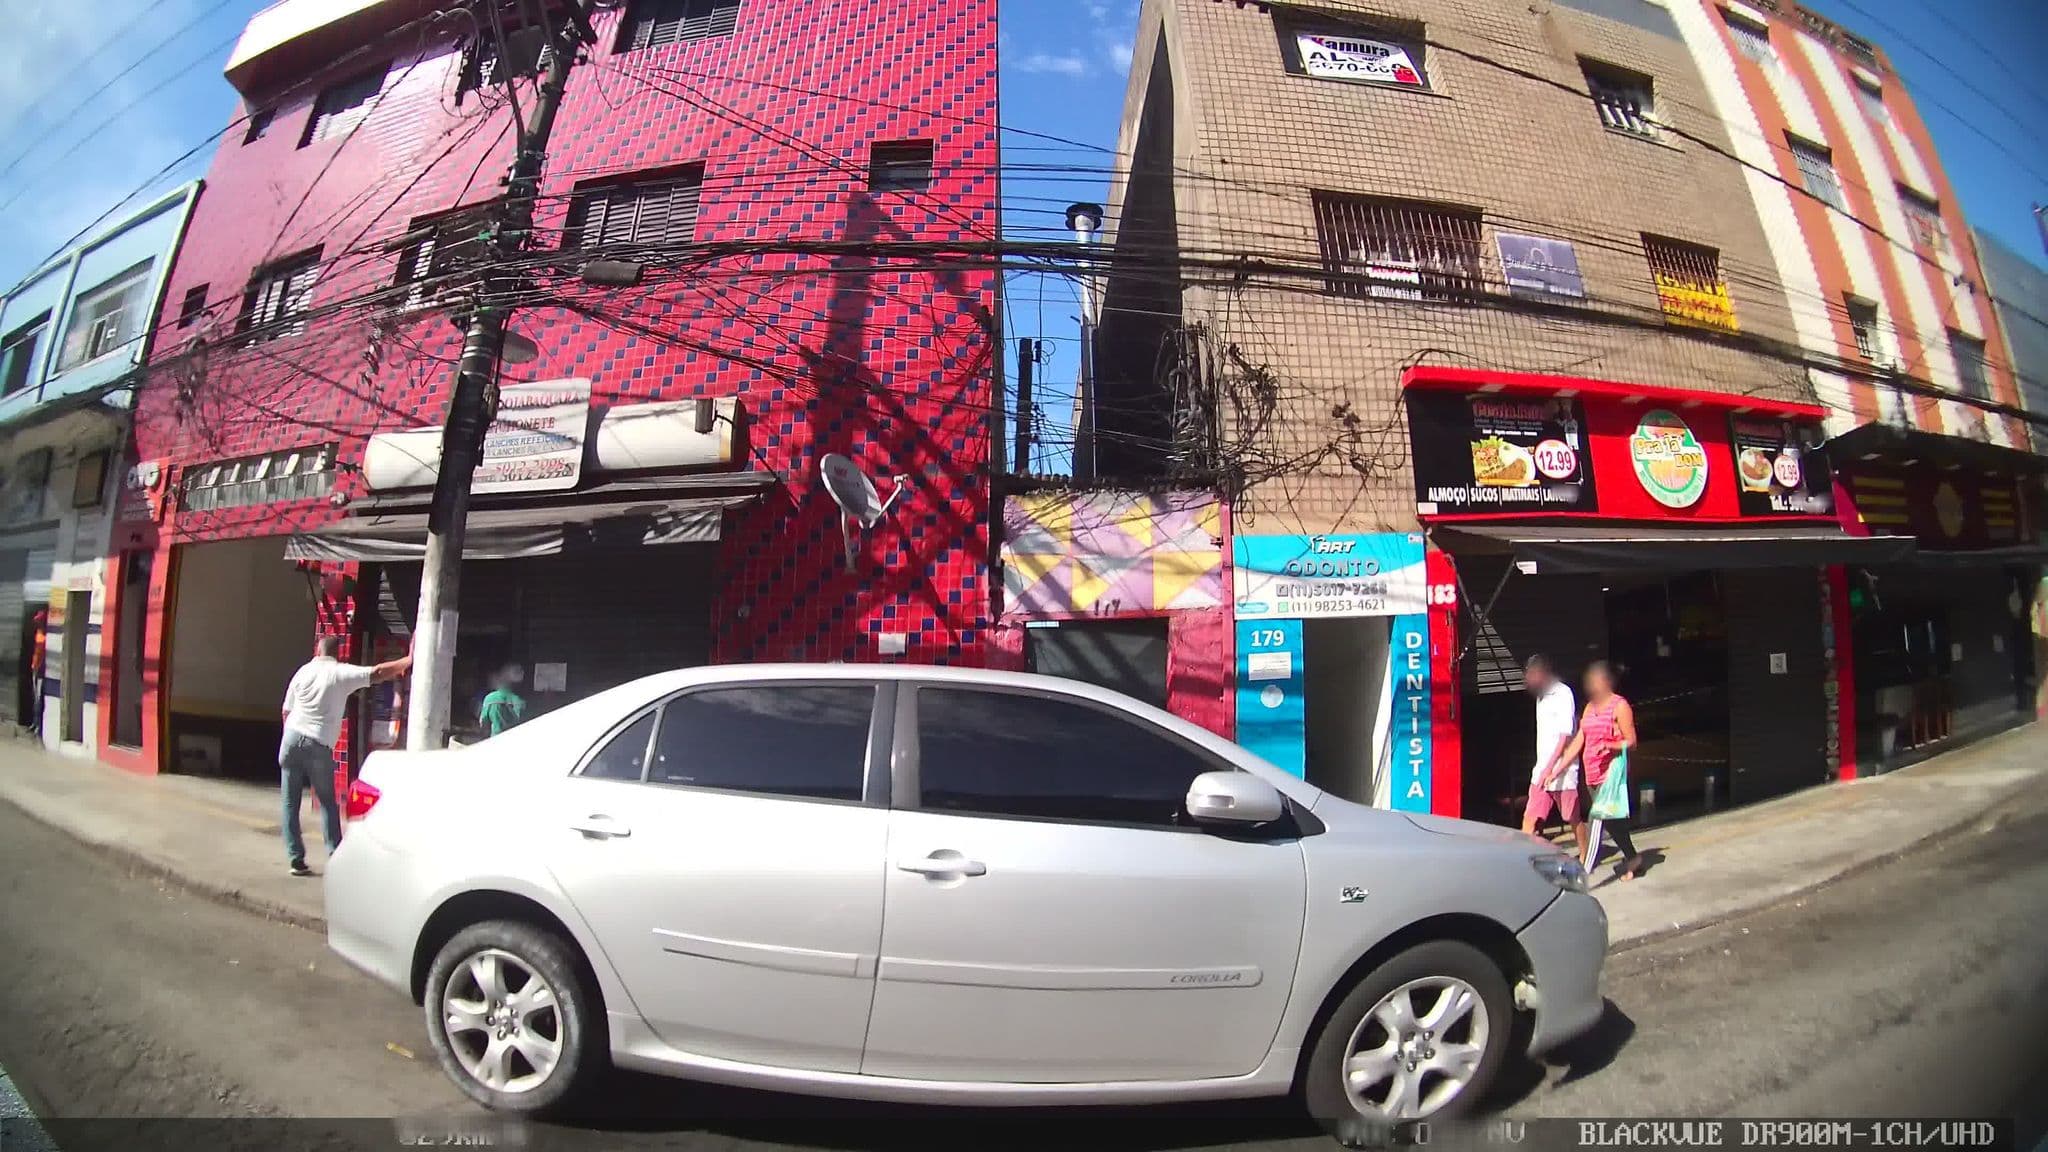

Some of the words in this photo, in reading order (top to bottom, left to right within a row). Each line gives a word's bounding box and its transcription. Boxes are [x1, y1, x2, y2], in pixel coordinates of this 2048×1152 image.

[1539, 451, 1572, 472] 12.99
[1674, 453, 1704, 467] BOM
[1428, 487, 1467, 506] ALMOÇO
[1470, 487, 1498, 503] SUCOS
[1501, 487, 1540, 502] MATINAIS
[1286, 559, 1380, 577] ODONTO
[1315, 599, 1387, 612] 98253-4621
[1251, 630, 1285, 648] 179
[1405, 632, 1425, 799] DENTISTA
[1170, 973, 1242, 984] COROLLA
